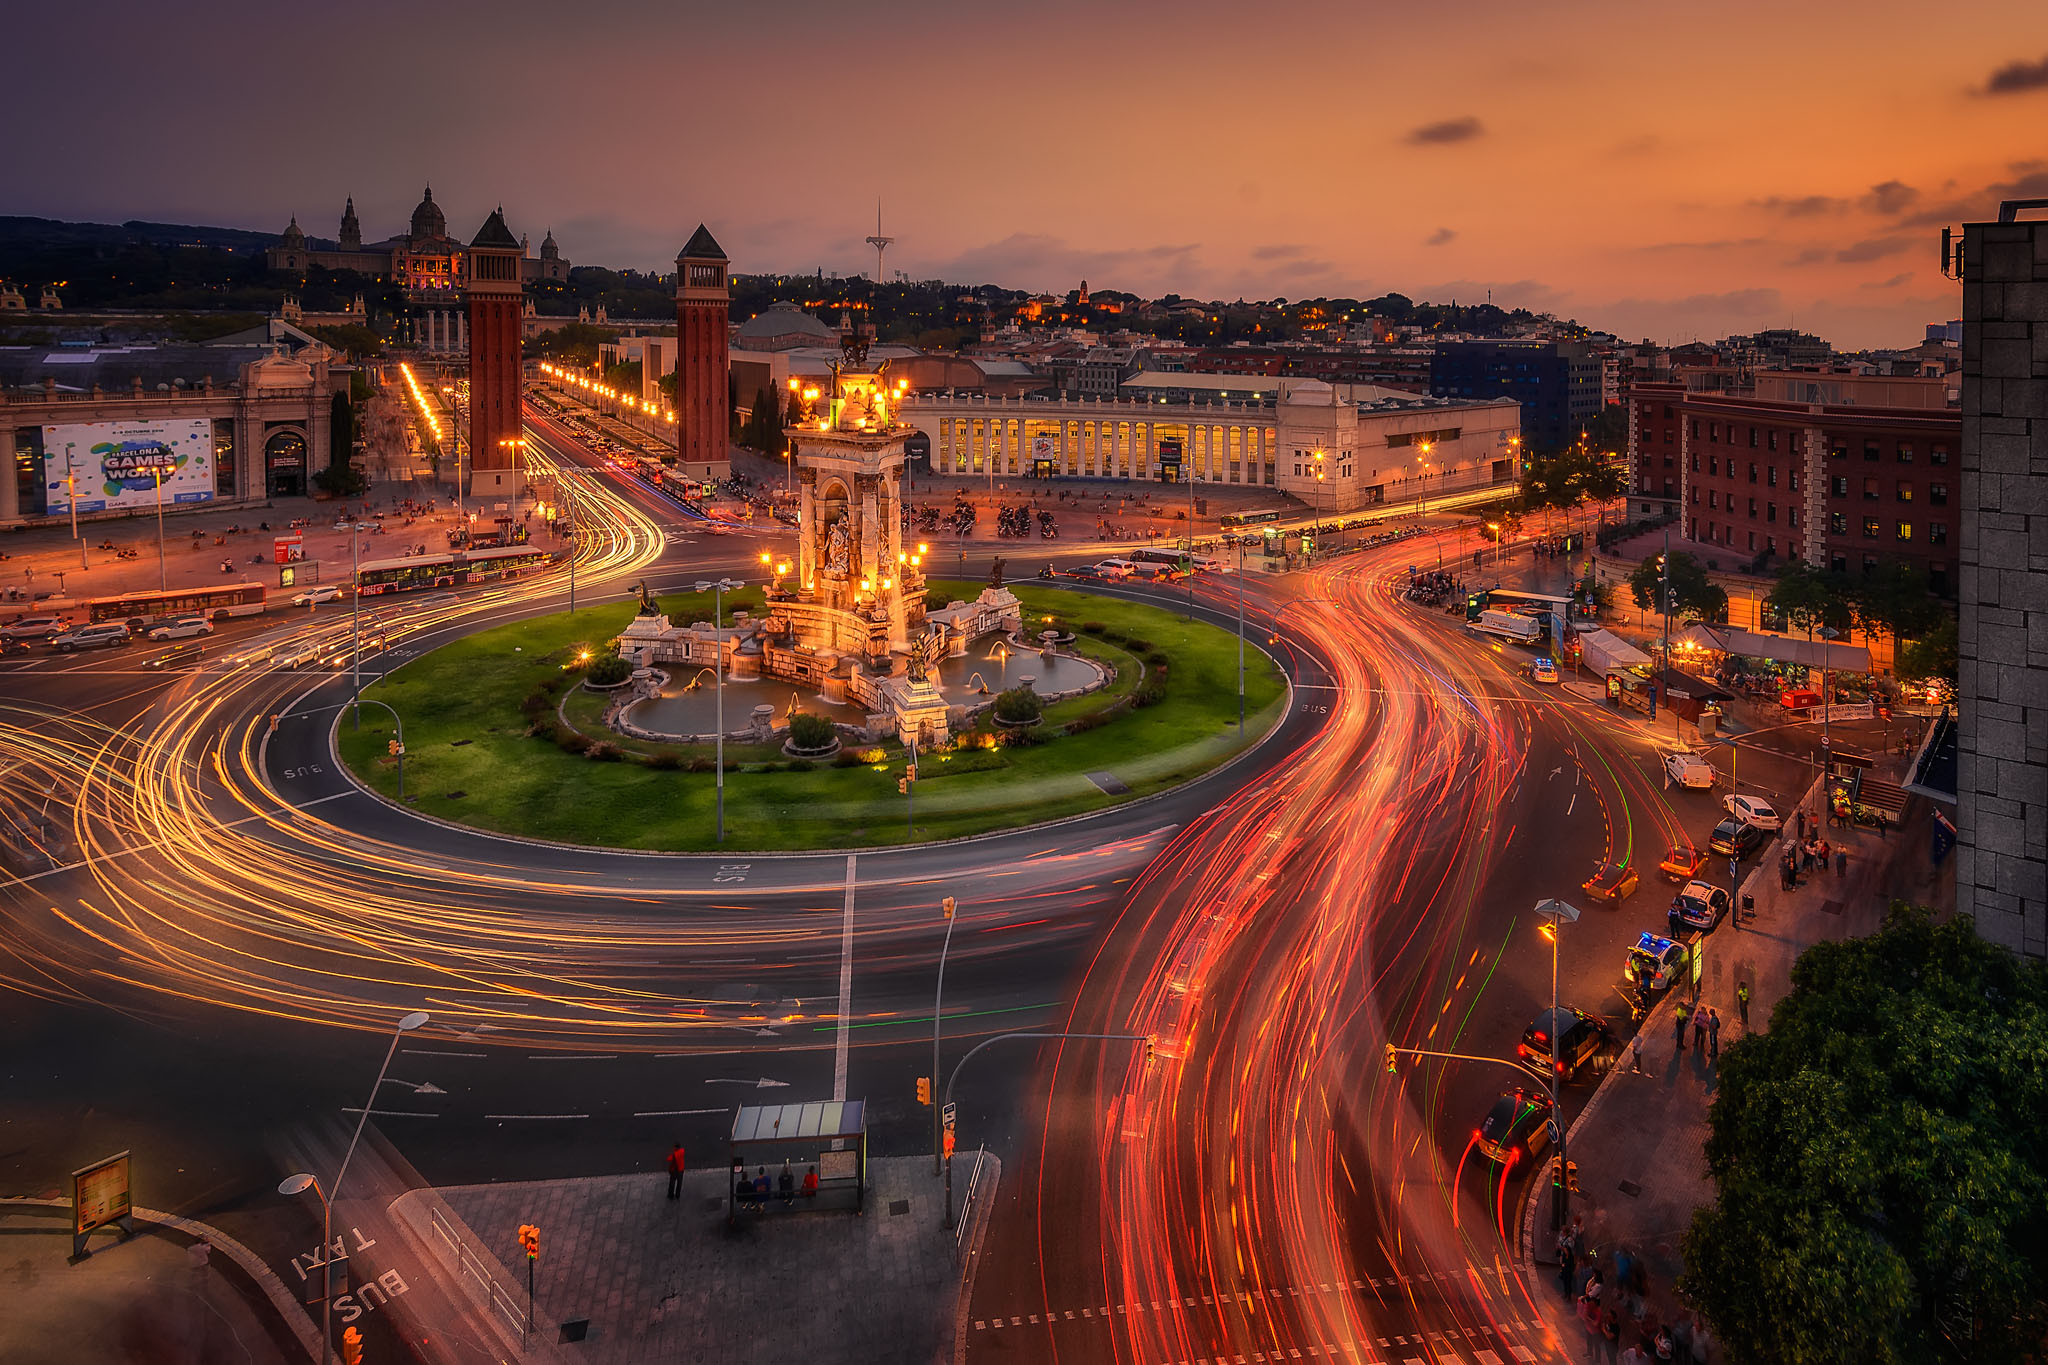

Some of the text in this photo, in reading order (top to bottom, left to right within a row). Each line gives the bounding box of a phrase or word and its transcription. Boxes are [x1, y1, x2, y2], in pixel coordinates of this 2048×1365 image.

[111, 447, 160, 457] BARCELONA
[104, 454, 175, 469] GAMES
[1301, 703, 1328, 714] BUS
[283, 764, 322, 779] BUS
[712, 864, 751, 882] BUS
[290, 1227, 377, 1281] TAXI
[332, 1268, 410, 1323] BUS
